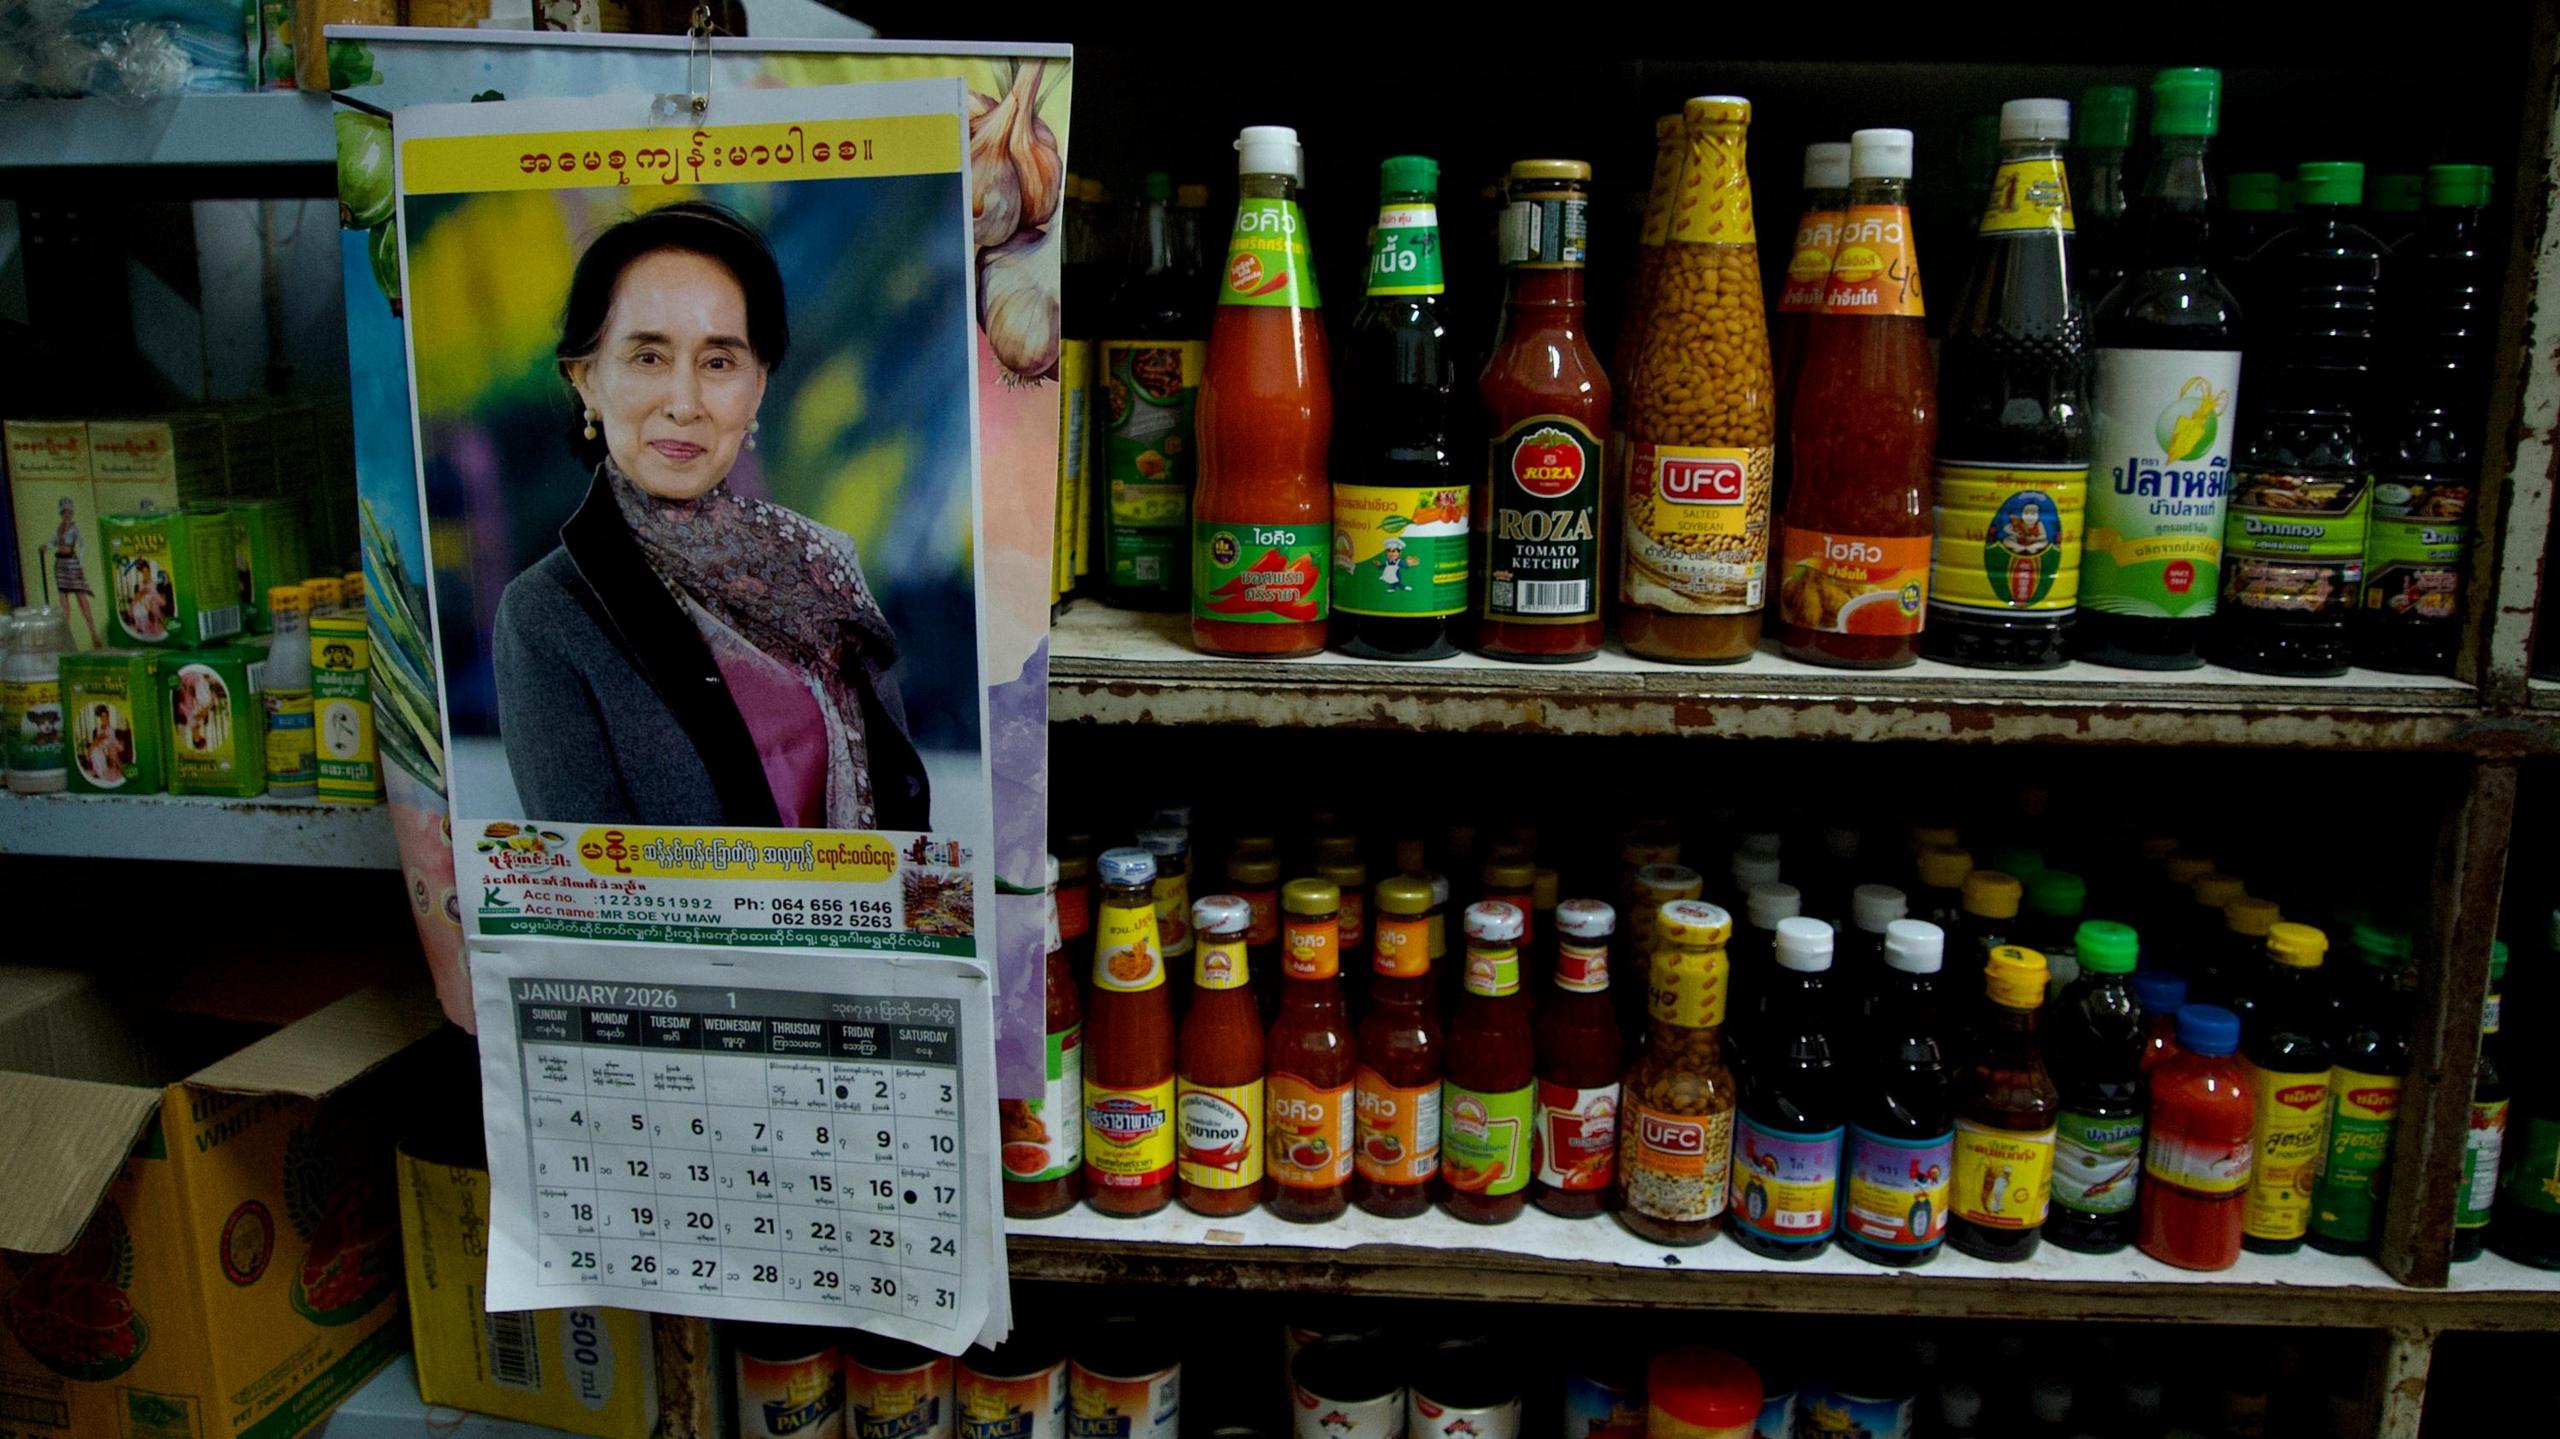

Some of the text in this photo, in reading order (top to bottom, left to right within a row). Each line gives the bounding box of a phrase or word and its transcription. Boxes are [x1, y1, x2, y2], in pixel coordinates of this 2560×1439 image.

[1522, 466, 1576, 480] ROZA
[1668, 467, 1736, 494] UFC
[1682, 510, 1720, 520] SALTED
[1499, 507, 1594, 541] ROZA
[1677, 521, 1724, 532] SOYBEAN
[1253, 526, 1296, 546] ไฮคิว
[1516, 545, 1577, 557] TOMATO
[1823, 535, 1883, 564] ไฮคิว
[1512, 557, 1580, 570] KETCHUP
[523, 890, 552, 901] Acc
[555, 893, 577, 904] no.
[524, 903, 553, 915] Acc
[627, 910, 657, 921] SOE
[660, 911, 682, 922] YU
[686, 912, 722, 924] MAW
[733, 897, 893, 914] Ph: 064 656 1646
[771, 913, 893, 928] 062 892 5263
[517, 983, 737, 1010] JANUARY 2026 1
[532, 1008, 568, 1022] SUNDAY
[591, 1011, 629, 1026] MONDAY
[650, 1016, 691, 1030] TUESDAY
[704, 1018, 762, 1033] WEDNESDAY
[772, 1021, 821, 1036] THRUSDAY
[842, 1025, 875, 1040] FRIDAY
[899, 1028, 948, 1043] SATURDAY
[817, 1079, 824, 1094] 1
[876, 1081, 887, 1098] 2
[941, 1085, 952, 1102] 3
[571, 1111, 583, 1126] 4
[632, 1115, 643, 1130] 5
[195, 1103, 264, 1153] WHITE
[692, 1119, 703, 1135] 6
[754, 1124, 765, 1139] 7
[817, 1127, 828, 1143] 8
[1646, 1119, 1697, 1148] UFC
[877, 1131, 890, 1147] 9
[931, 1135, 953, 1153] 10
[573, 1156, 588, 1172] 11
[628, 1161, 648, 1177] 12
[688, 1166, 709, 1181] 13
[747, 1170, 770, 1186] 14
[810, 1176, 832, 1191] 15
[870, 1180, 892, 1197] 16
[934, 1187, 955, 1203] 17
[571, 1204, 592, 1220] 18
[632, 1208, 653, 1224] 19
[687, 1212, 713, 1229] 20
[755, 1217, 774, 1234] 21
[812, 1223, 835, 1240] 22
[870, 1229, 894, 1247] 23
[931, 1237, 955, 1256] 24
[572, 1251, 595, 1268] 25
[632, 1255, 656, 1272] 26
[692, 1260, 716, 1277] 27
[754, 1265, 777, 1282] 28
[814, 1271, 838, 1288] 29
[871, 1277, 896, 1296] 30
[936, 1289, 954, 1309] 31
[571, 1310, 601, 1401] 500 ml
